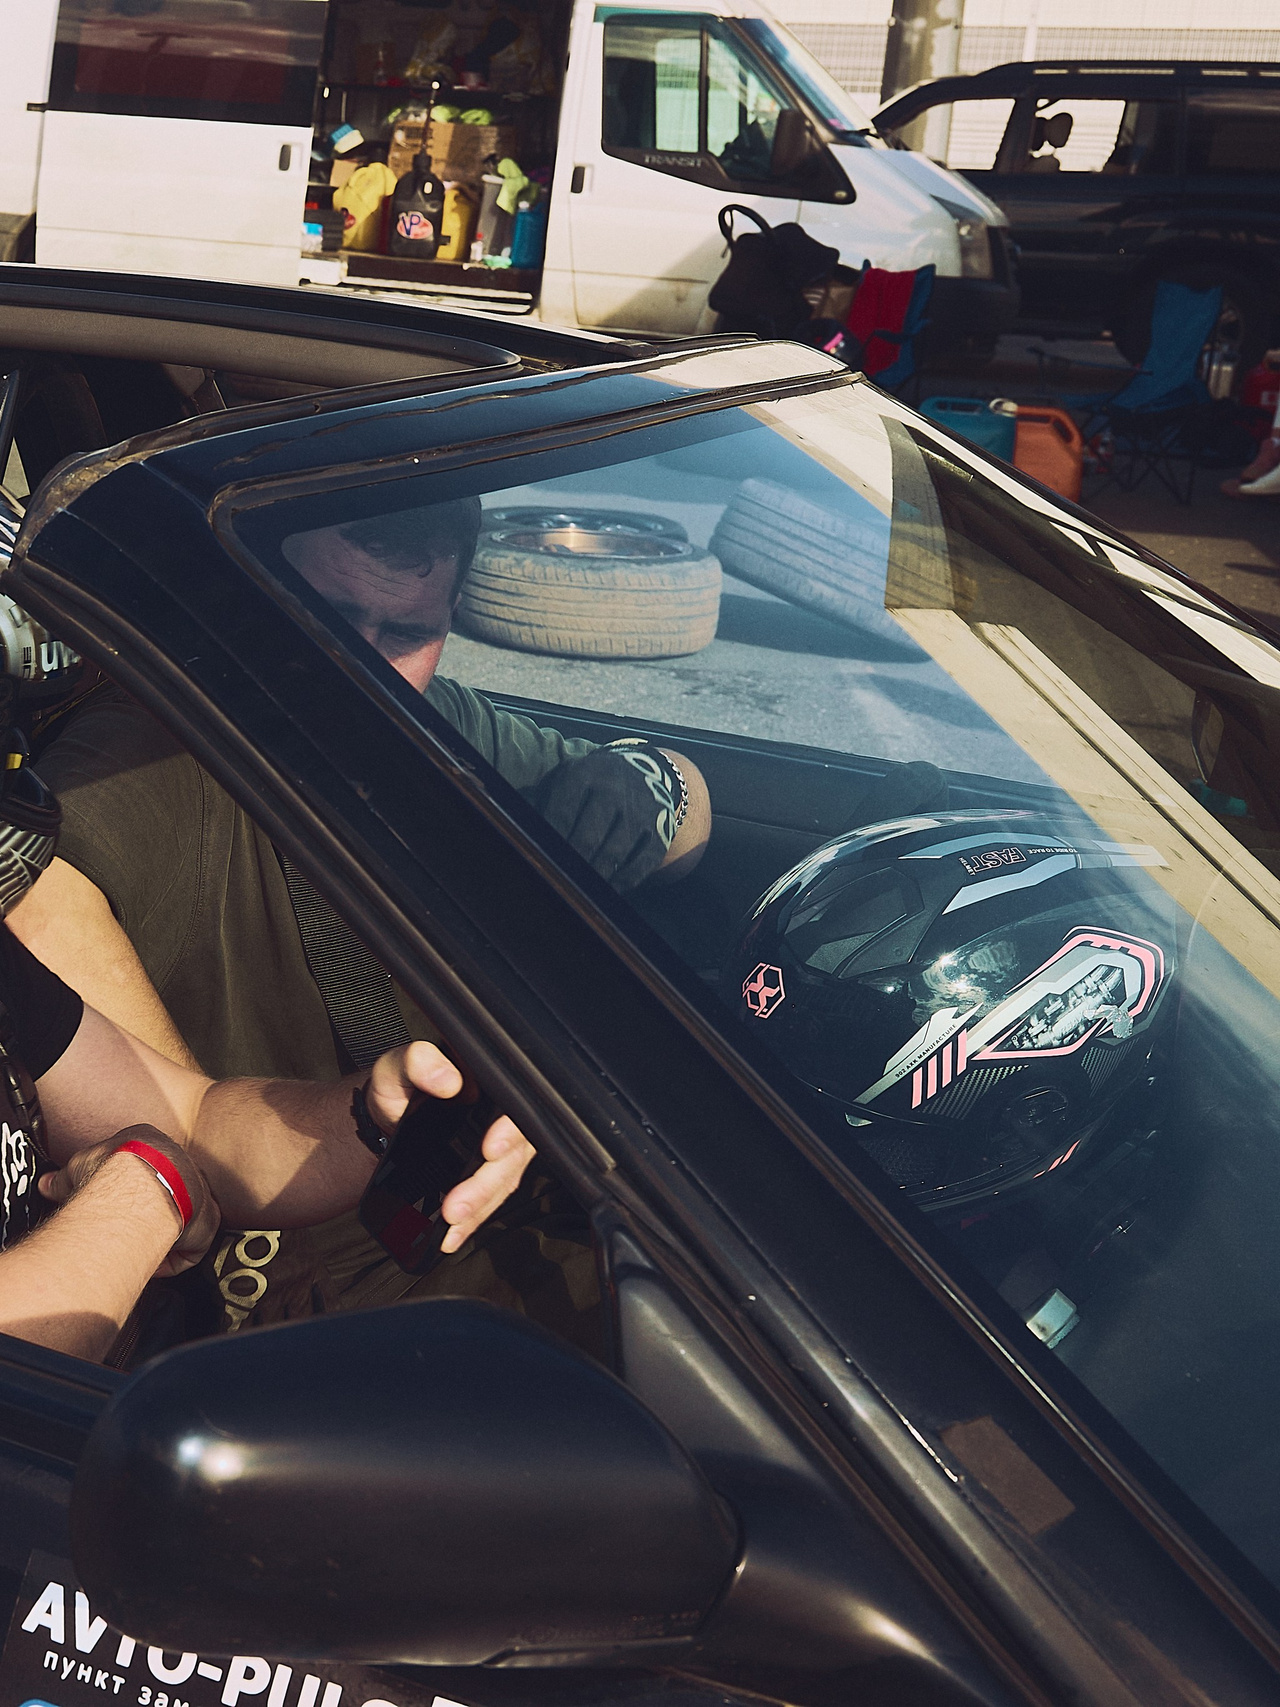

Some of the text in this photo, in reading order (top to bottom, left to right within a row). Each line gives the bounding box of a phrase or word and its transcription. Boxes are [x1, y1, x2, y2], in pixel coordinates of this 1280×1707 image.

[643, 154, 703, 168] TRANSIT
[970, 847, 1027, 872] FAST
[43, 1650, 126, 1694] пункт
